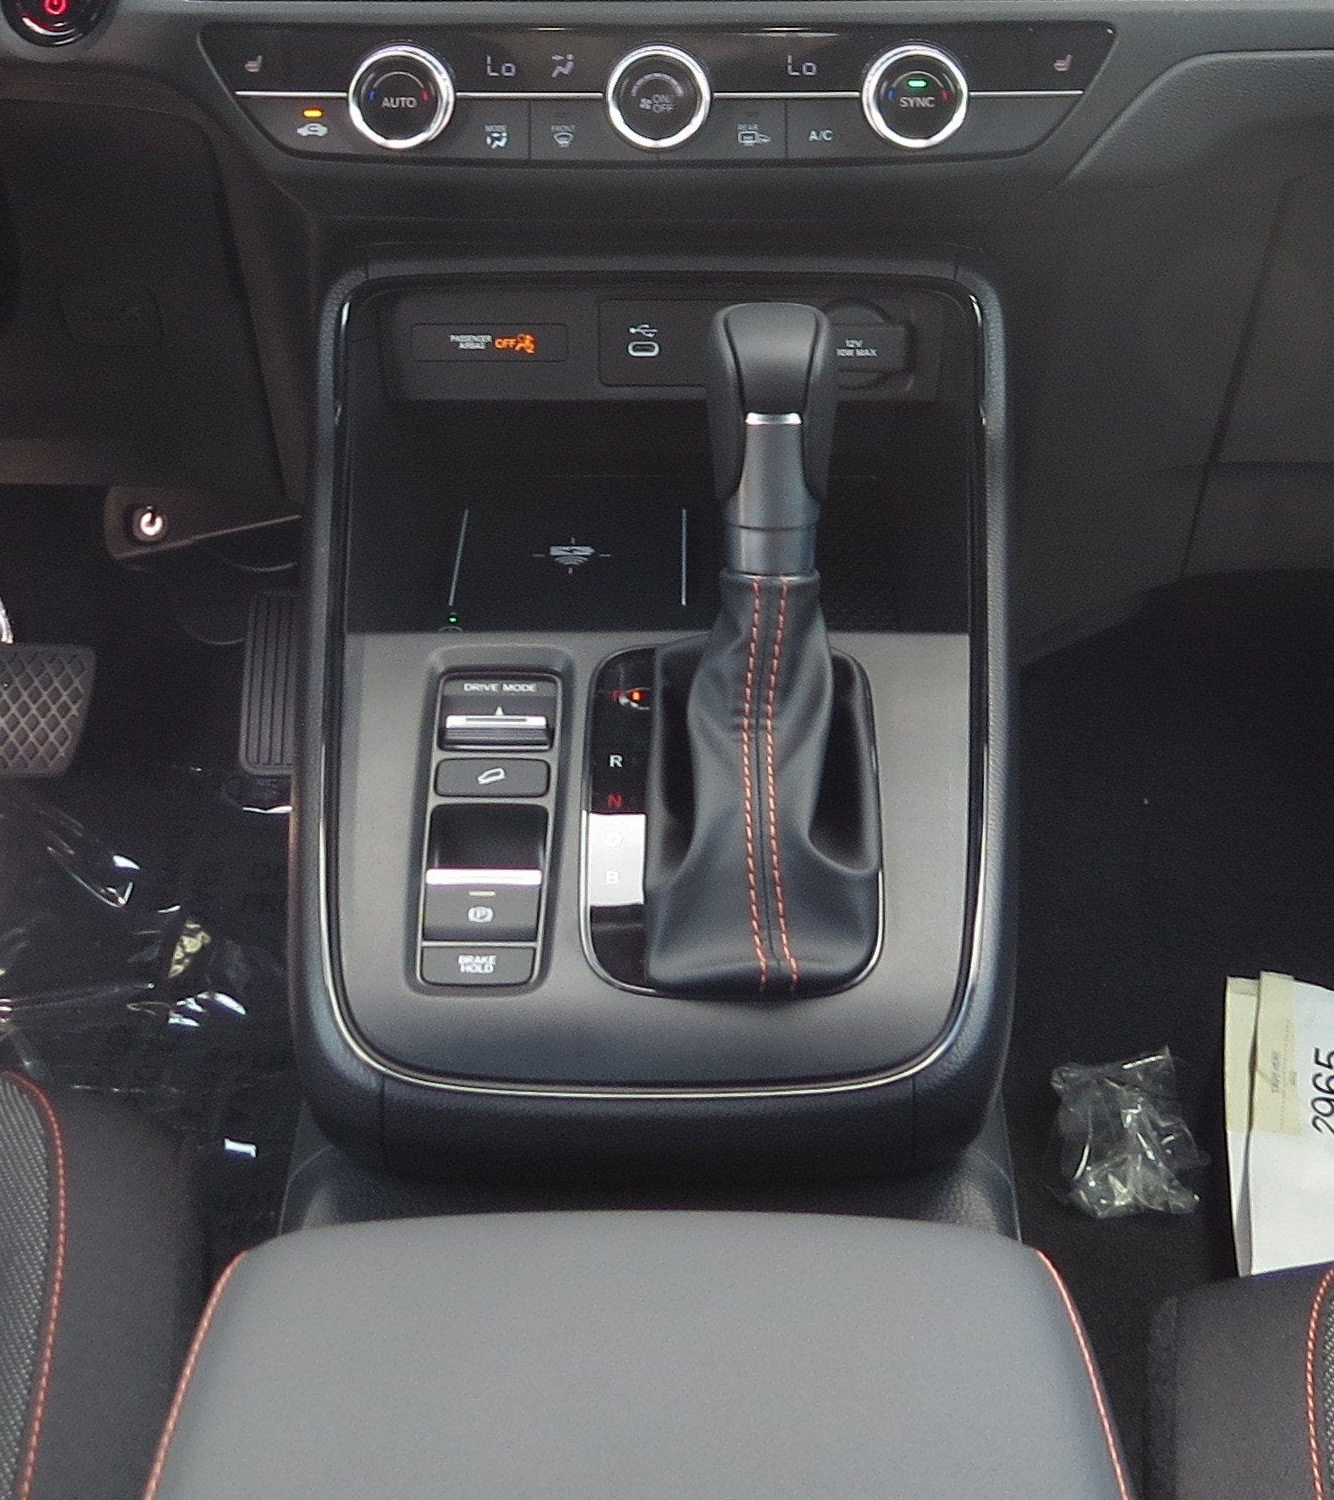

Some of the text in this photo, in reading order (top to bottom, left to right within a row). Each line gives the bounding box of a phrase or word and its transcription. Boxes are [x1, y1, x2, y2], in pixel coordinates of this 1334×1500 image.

[381, 97, 417, 108] AUTO
[899, 97, 935, 109] SYNC
[808, 129, 833, 142] A/C
[494, 338, 518, 349] OFF
[464, 683, 537, 692] DRIVE MODE
[609, 754, 623, 768] R
[458, 955, 497, 965] BRAKE
[459, 964, 494, 973] HOLD
